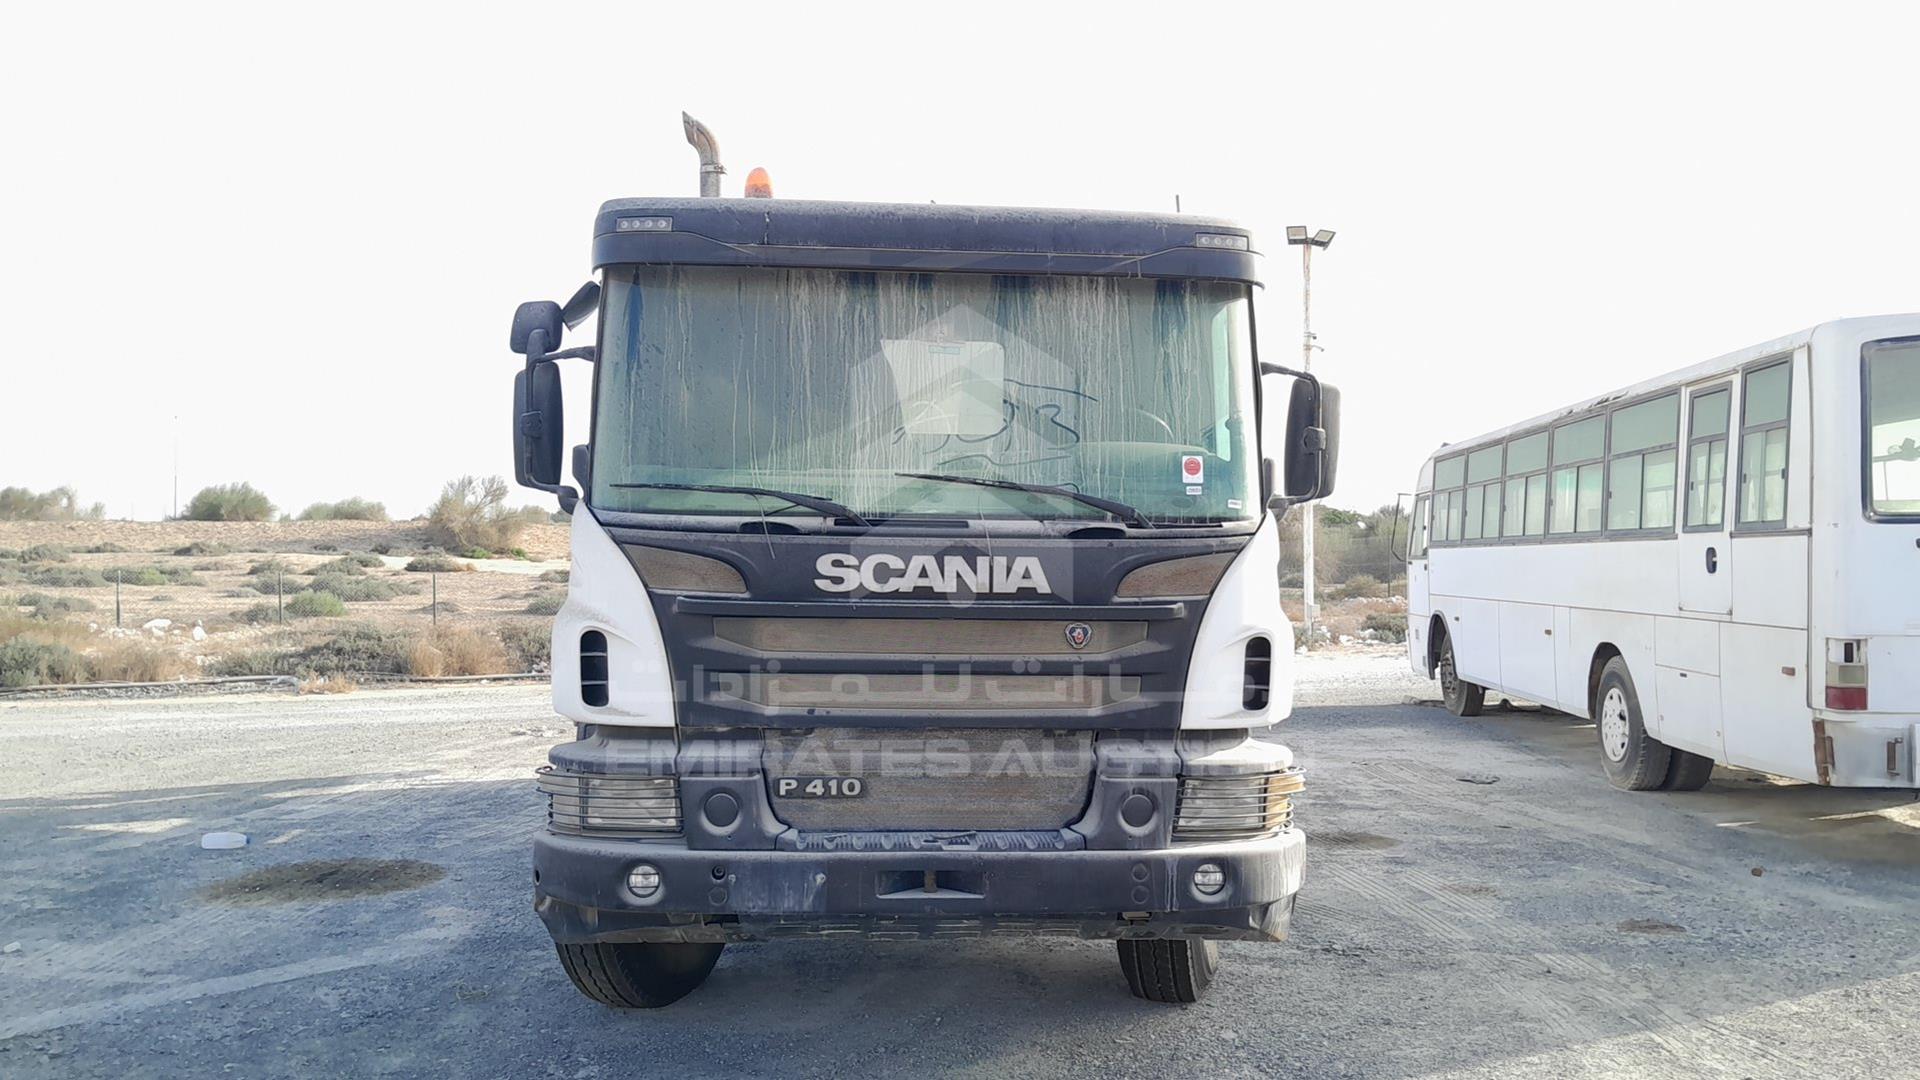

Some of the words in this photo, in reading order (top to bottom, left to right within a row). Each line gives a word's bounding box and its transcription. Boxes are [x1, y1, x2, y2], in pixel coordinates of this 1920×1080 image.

[814, 553, 1051, 593] SCANIA
[779, 779, 798, 796] P
[804, 779, 861, 796] 410
